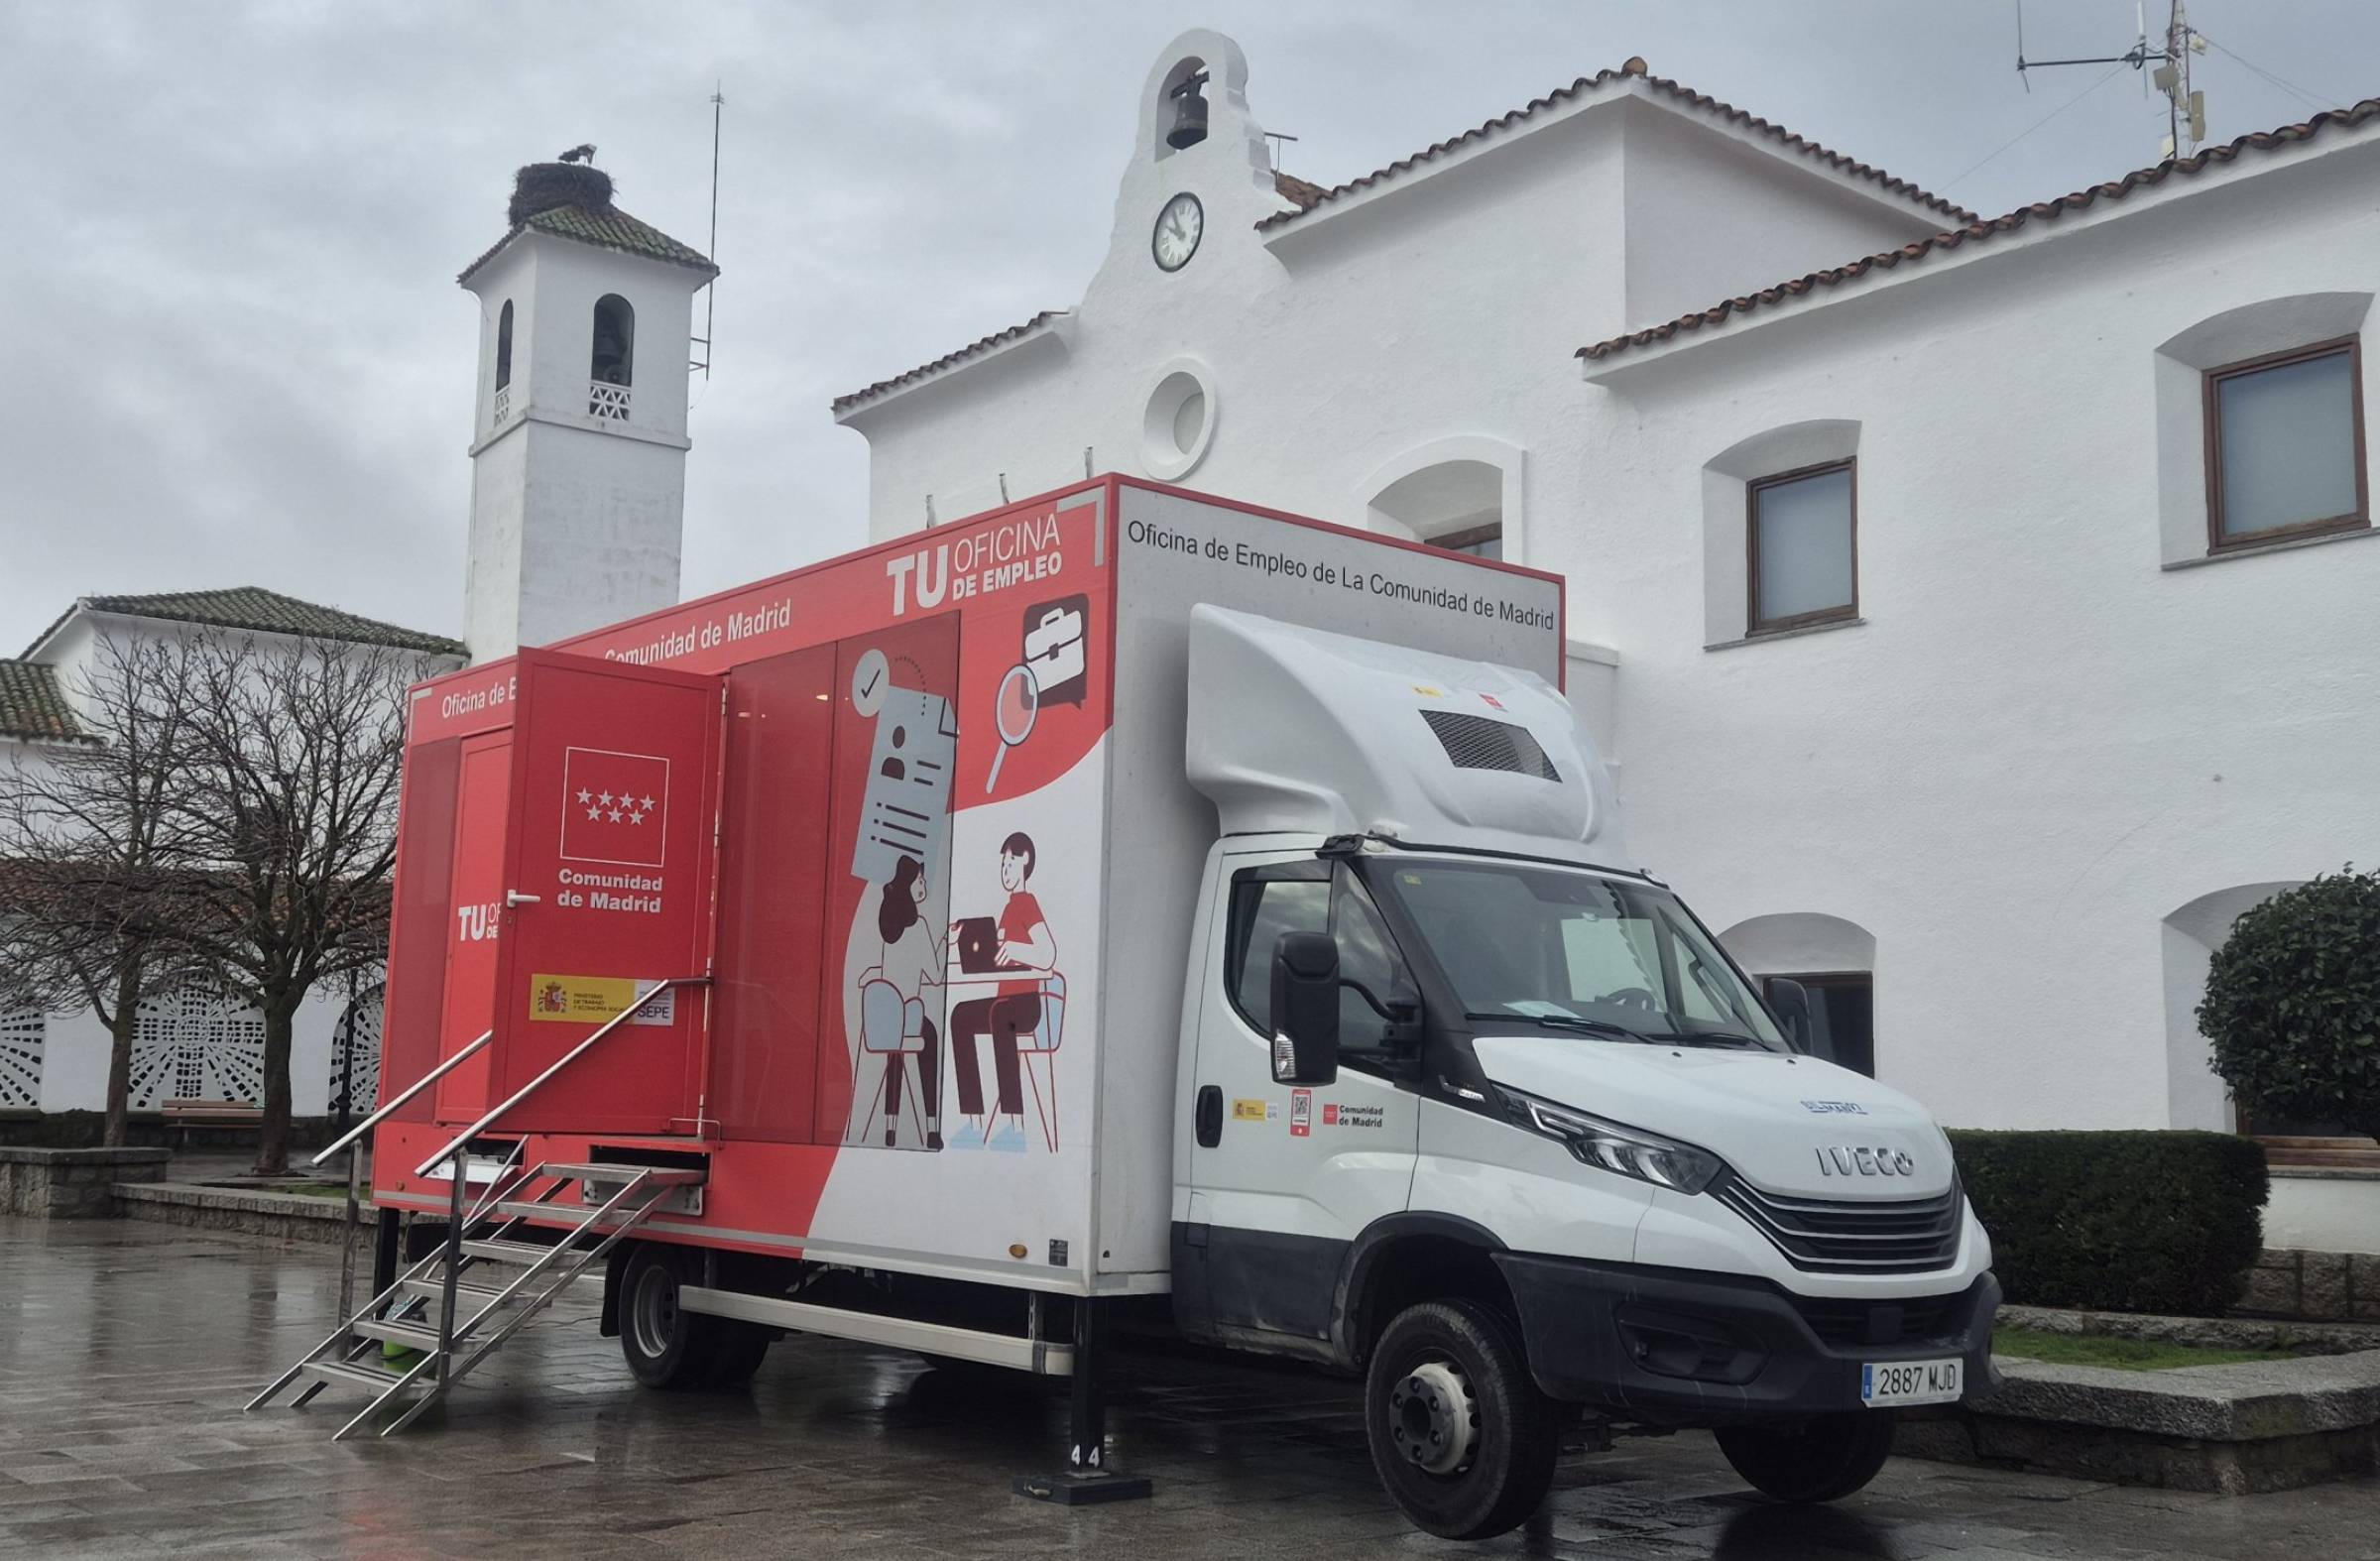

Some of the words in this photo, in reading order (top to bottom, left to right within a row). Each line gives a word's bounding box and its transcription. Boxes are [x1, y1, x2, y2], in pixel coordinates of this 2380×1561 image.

[954, 513, 1061, 573] OFICINA
[887, 544, 949, 617] TU
[952, 574, 977, 601] DE
[982, 551, 1062, 593] EMPLEO
[1128, 520, 1199, 555] Oficina
[1204, 538, 1229, 561] de
[1236, 542, 1308, 578] Empleo
[1313, 561, 1336, 584] de
[1342, 566, 1364, 591] La
[1369, 573, 1468, 612] Comunidad
[1474, 596, 1494, 618] de
[1499, 600, 1554, 631] Madrid
[700, 621, 722, 650] de
[727, 598, 791, 643] Madrid
[442, 689, 486, 719] Oficina
[489, 681, 506, 706] de
[558, 869, 662, 891] Comunidad
[557, 891, 583, 907] de
[590, 892, 661, 913] Madrid
[458, 903, 486, 941] TU
[638, 1006, 670, 1019] SEPE
[1339, 1105, 1383, 1116] Comunidad
[1339, 1117, 1349, 1126] de
[1352, 1118, 1382, 1128] Madrid
[1816, 1146, 1914, 1176] IVECO
[1879, 1367, 1923, 1395] 2887
[1929, 1364, 1956, 1392] MJD
